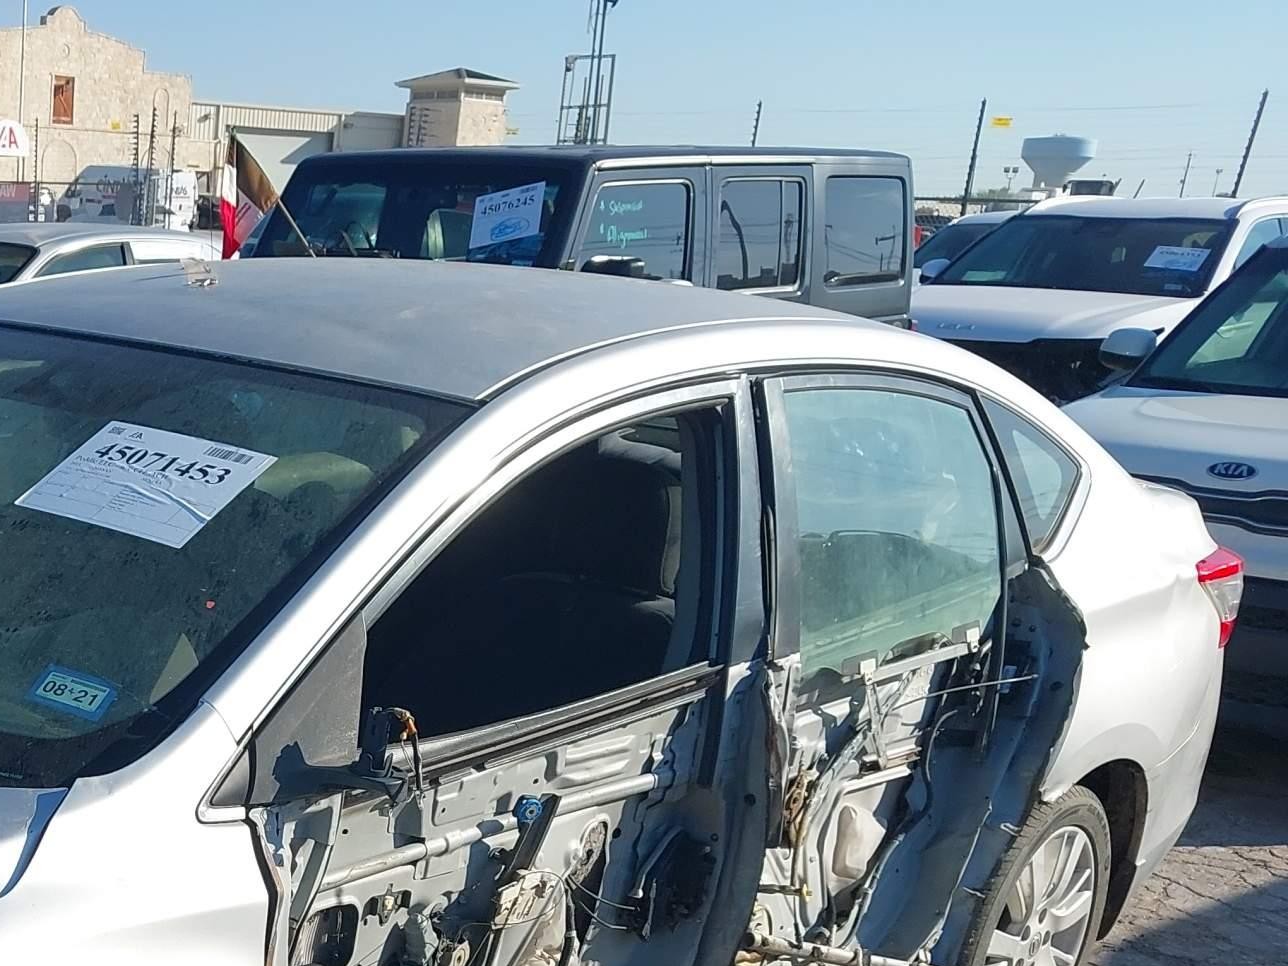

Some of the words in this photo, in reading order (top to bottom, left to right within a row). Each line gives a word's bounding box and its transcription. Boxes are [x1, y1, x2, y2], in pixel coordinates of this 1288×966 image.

[481, 195, 535, 216] 45076245
[95, 443, 231, 485] 45071453
[1214, 463, 1249, 476] KIA
